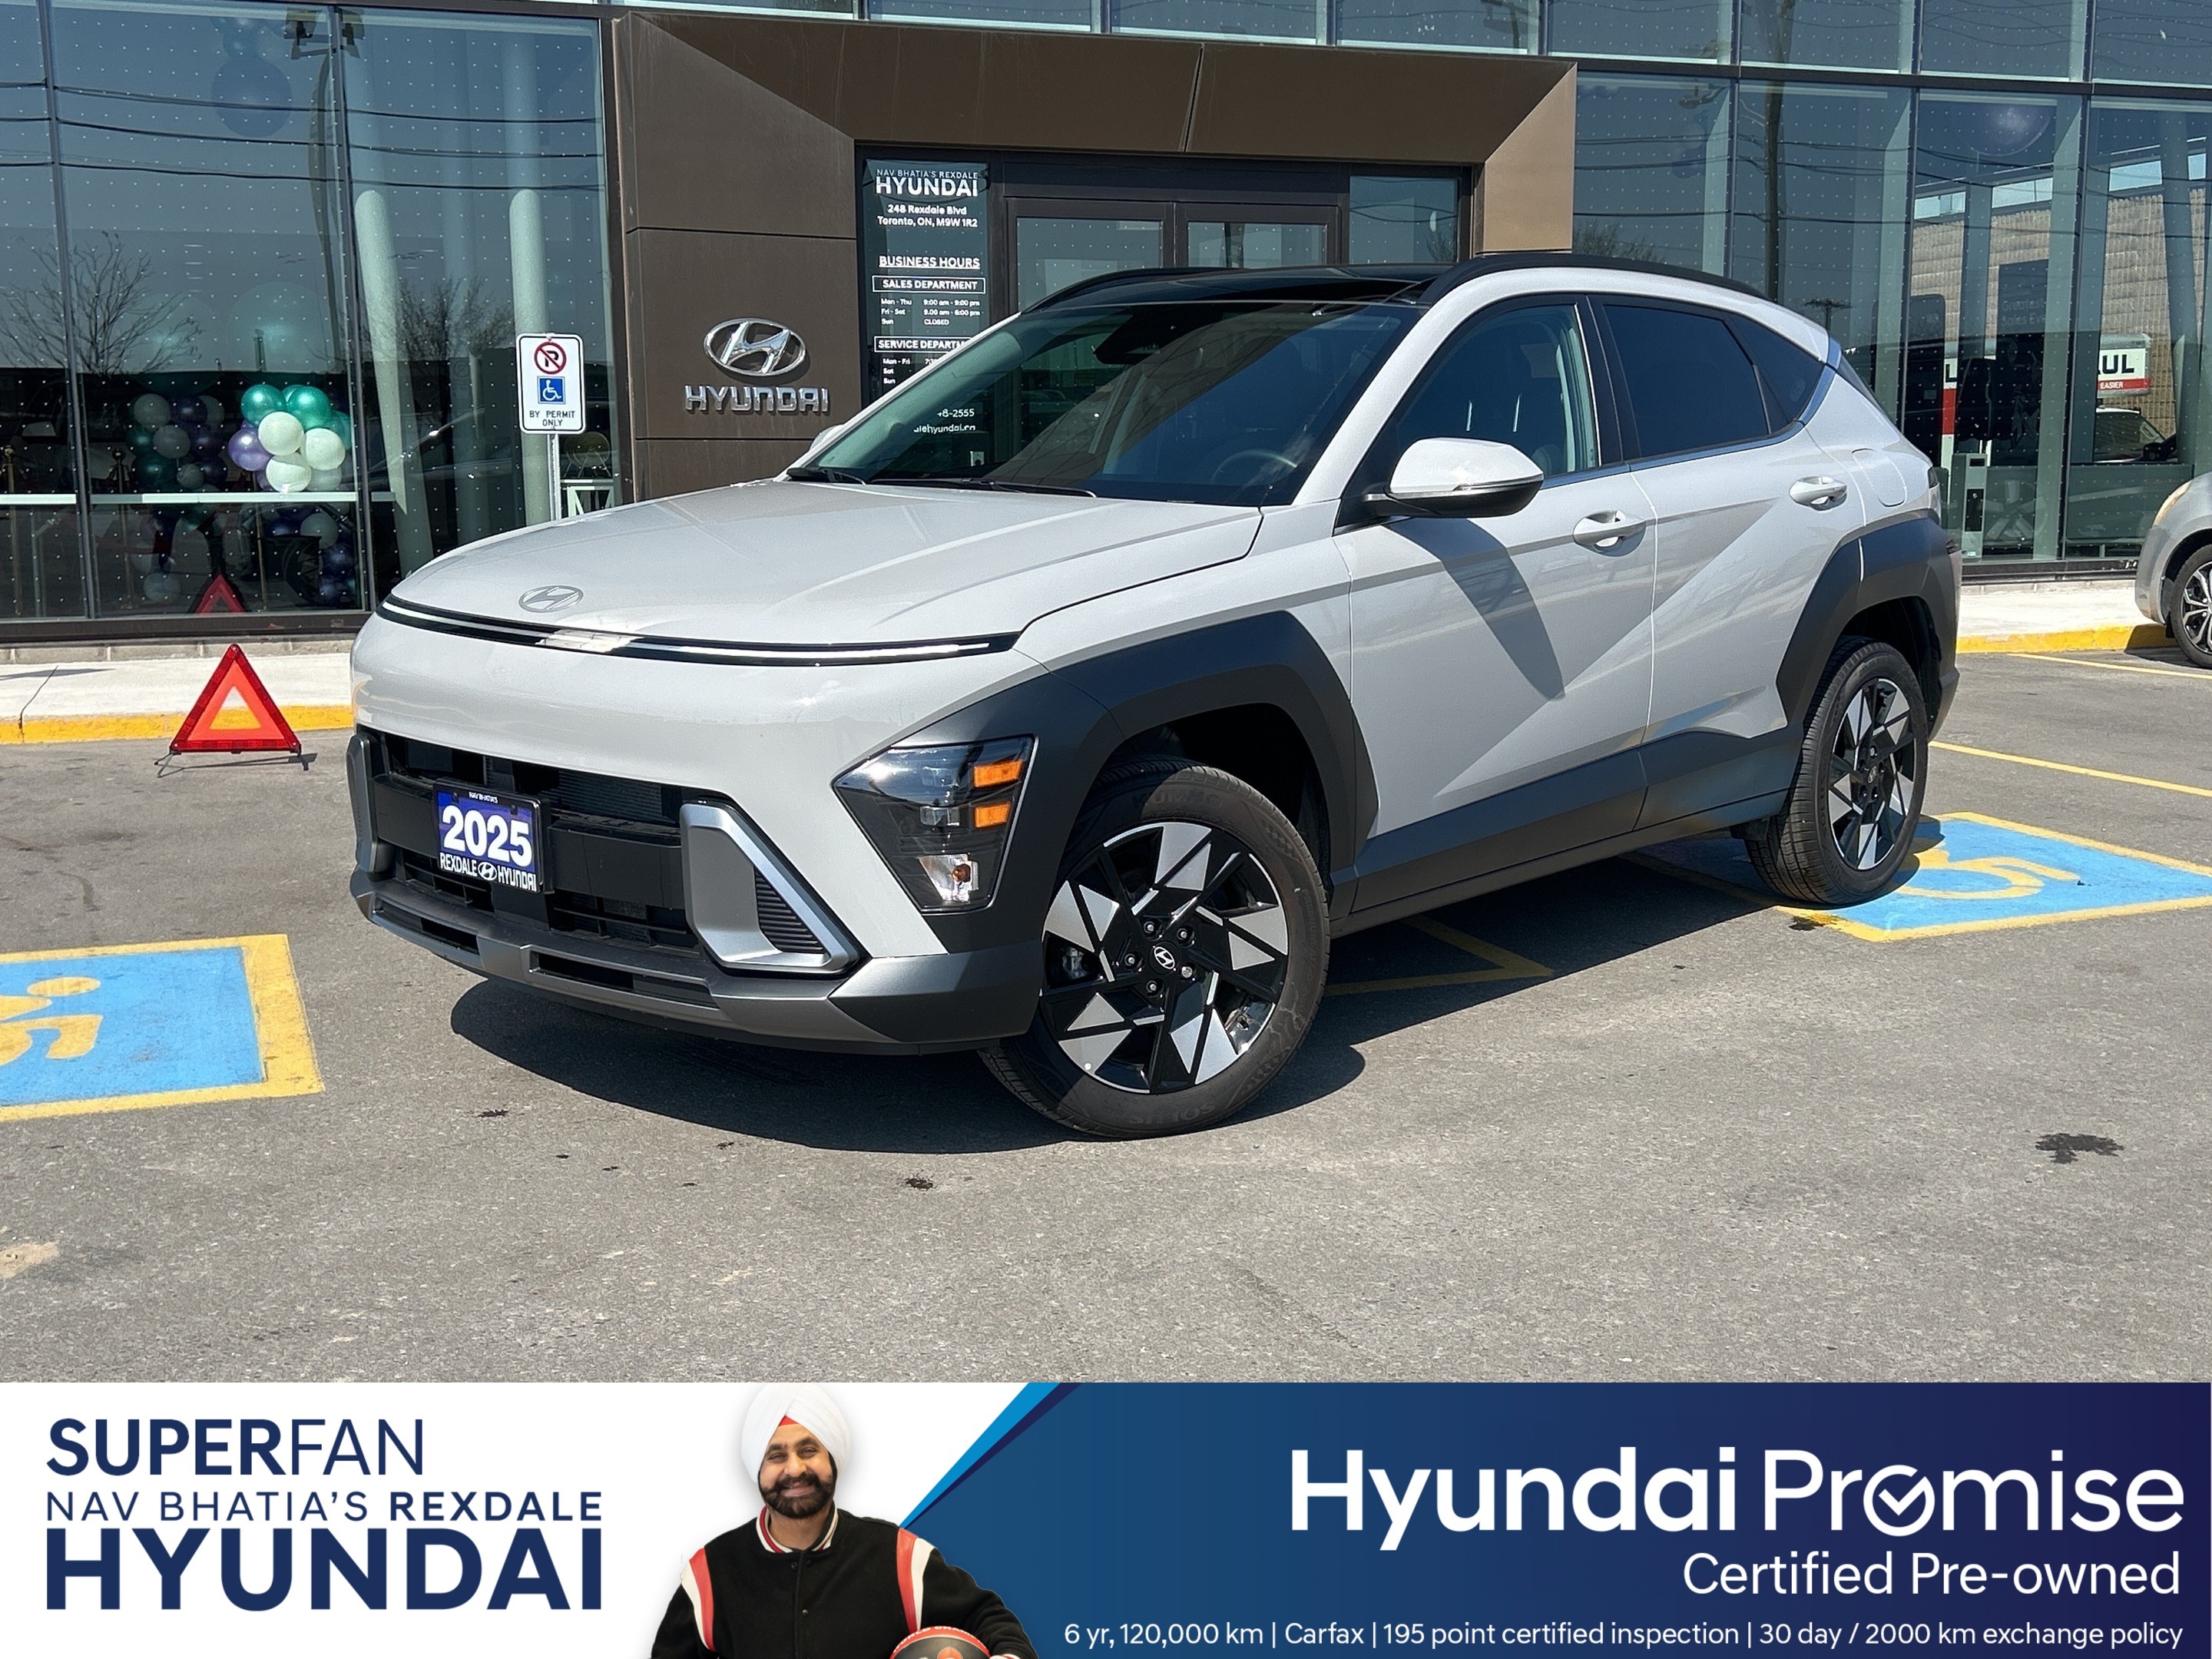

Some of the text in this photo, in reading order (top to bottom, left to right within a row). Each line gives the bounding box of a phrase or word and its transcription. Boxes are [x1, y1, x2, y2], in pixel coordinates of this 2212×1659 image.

[876, 176, 978, 197] HYUNDAI
[887, 204, 967, 215] 248 Rexdale Blvd
[877, 216, 978, 227] Toronto, ON, M9W 1R2
[879, 256, 980, 269] BUSINESS HOURS
[882, 280, 978, 290] SALES DEPARTMENT
[878, 339, 919, 349] SERVICE
[2098, 354, 2134, 374] UL
[684, 385, 829, 412] HYUNDAI
[442, 805, 532, 867] 2025
[439, 853, 537, 892] REXDALE HYUNDAI
